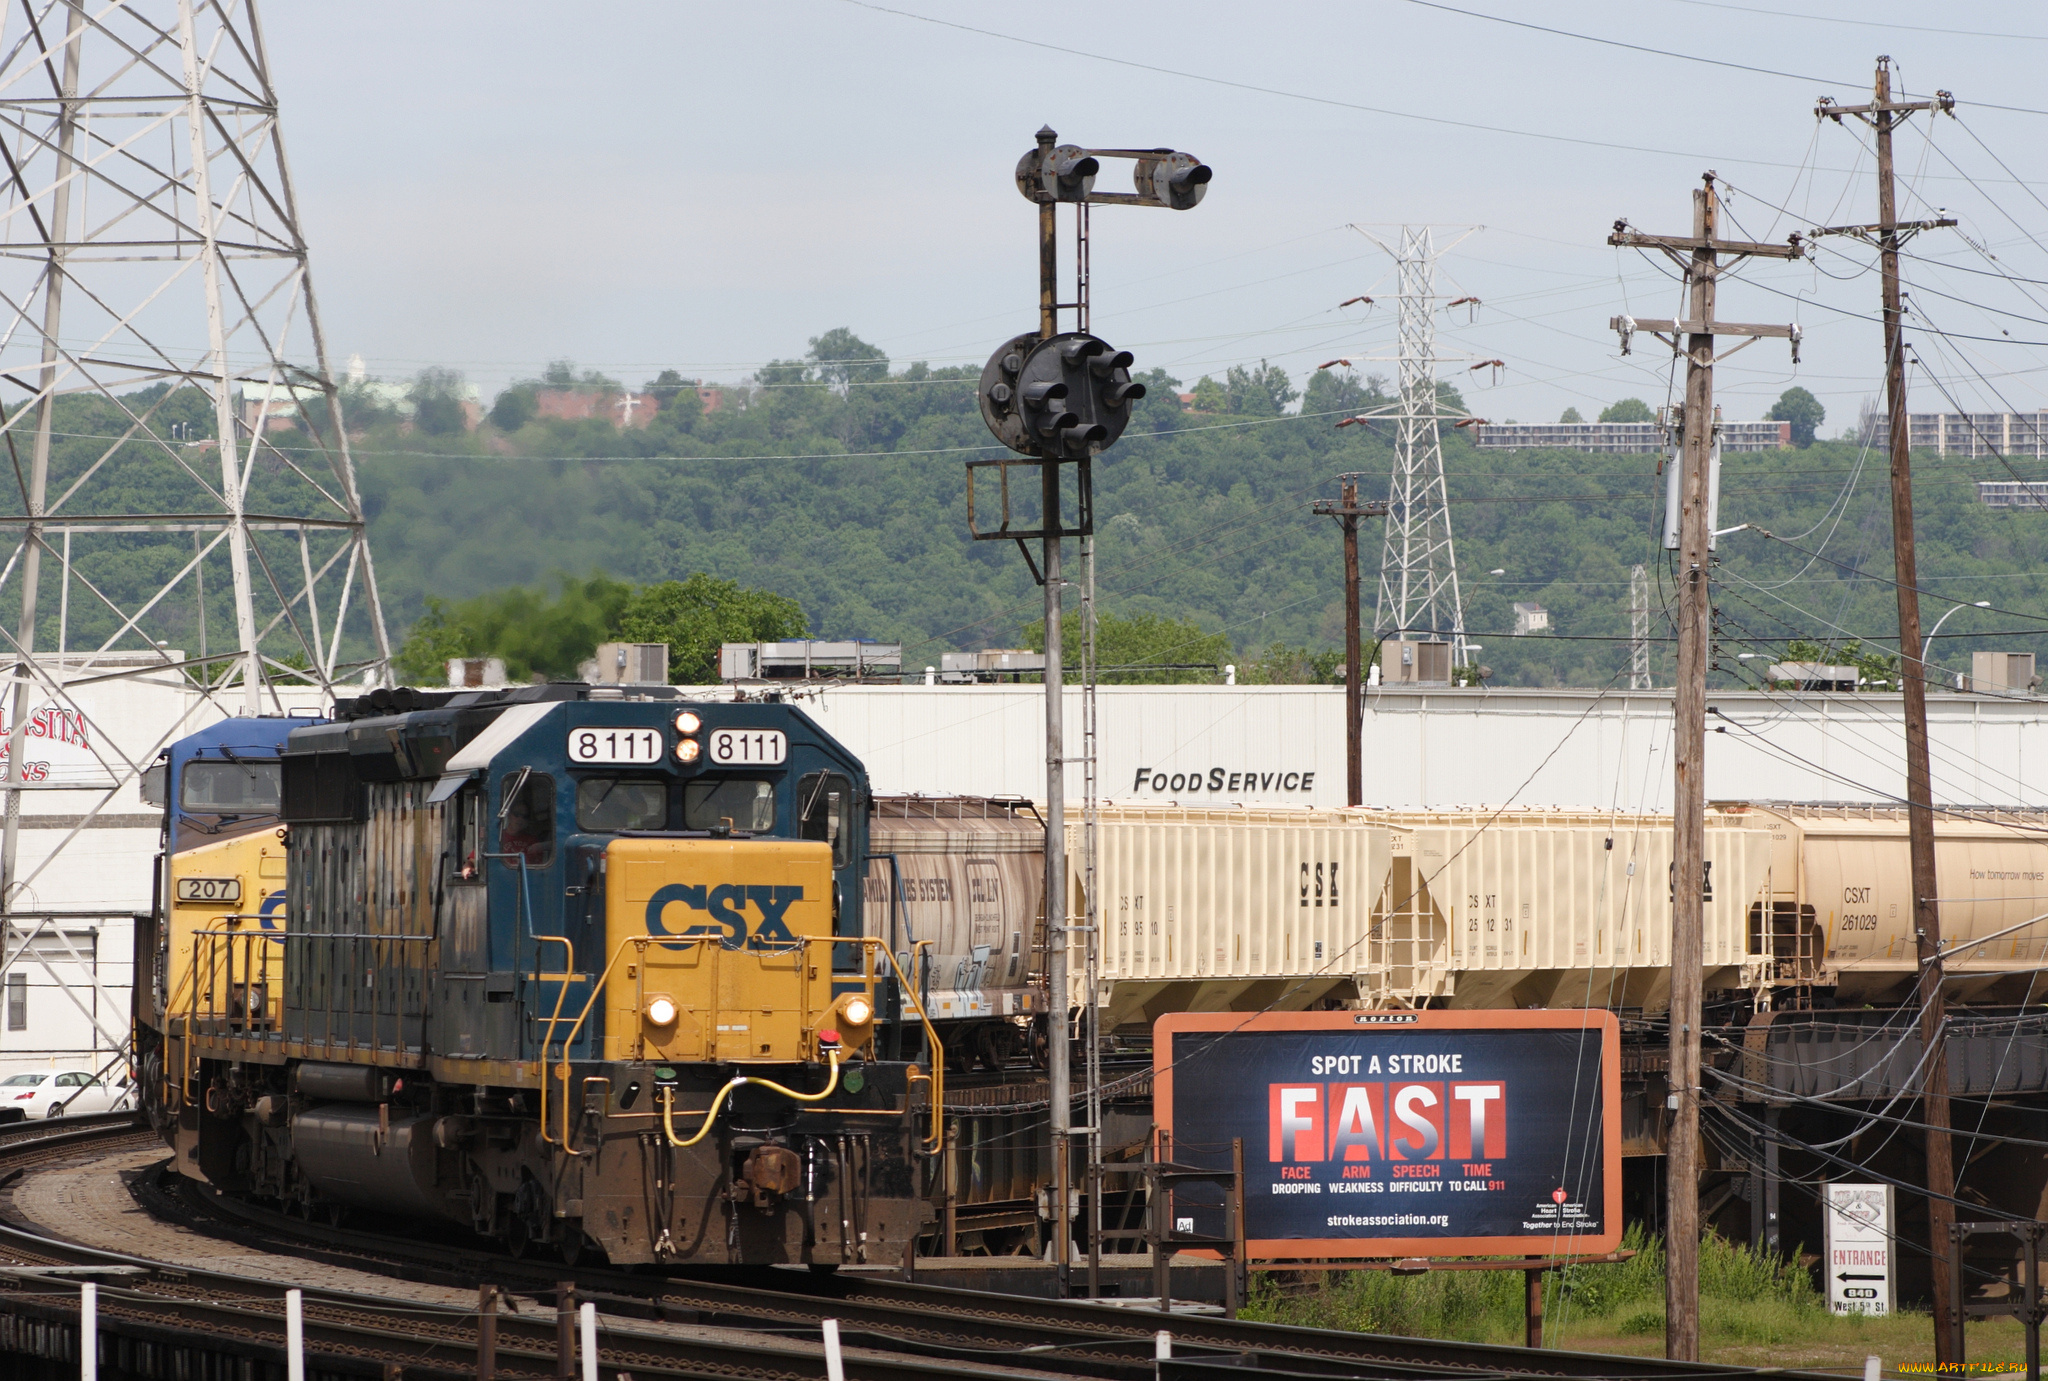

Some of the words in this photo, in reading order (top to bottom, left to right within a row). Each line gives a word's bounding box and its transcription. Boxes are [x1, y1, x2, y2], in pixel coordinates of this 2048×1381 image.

[578, 732, 653, 759] 8111
[717, 733, 779, 761] 8111
[1300, 862, 1339, 898] CSX
[1969, 868, 1985, 880] How
[1987, 869, 2020, 880] tomorrow
[2022, 871, 2045, 881] moves
[189, 880, 231, 898] 207
[1844, 887, 1871, 904] CSXT
[645, 883, 804, 951] CSX
[1841, 914, 1877, 931] 261029
[1311, 1055, 1362, 1075] SPOT
[1368, 1055, 1382, 1074] A
[1388, 1054, 1463, 1074] STROKE
[1281, 1084, 1501, 1162] FAST
[1281, 1166, 1311, 1180] FACE
[1342, 1165, 1371, 1178] ARM
[1392, 1164, 1440, 1178] SPEECH
[1462, 1163, 1492, 1177] TIME
[1272, 1182, 1321, 1195] DROOPING
[1328, 1181, 1384, 1194] WEAKNESS
[1389, 1180, 1443, 1193] DIFFICULTY
[1449, 1180, 1462, 1192] TO
[1463, 1180, 1487, 1192] CALL
[1488, 1180, 1505, 1191] 911
[1327, 1213, 1449, 1228] strokeassociation.org
[1522, 1221, 1553, 1230] Together
[1833, 1249, 1886, 1266] ENTRANCE
[1834, 1301, 1856, 1312] West
